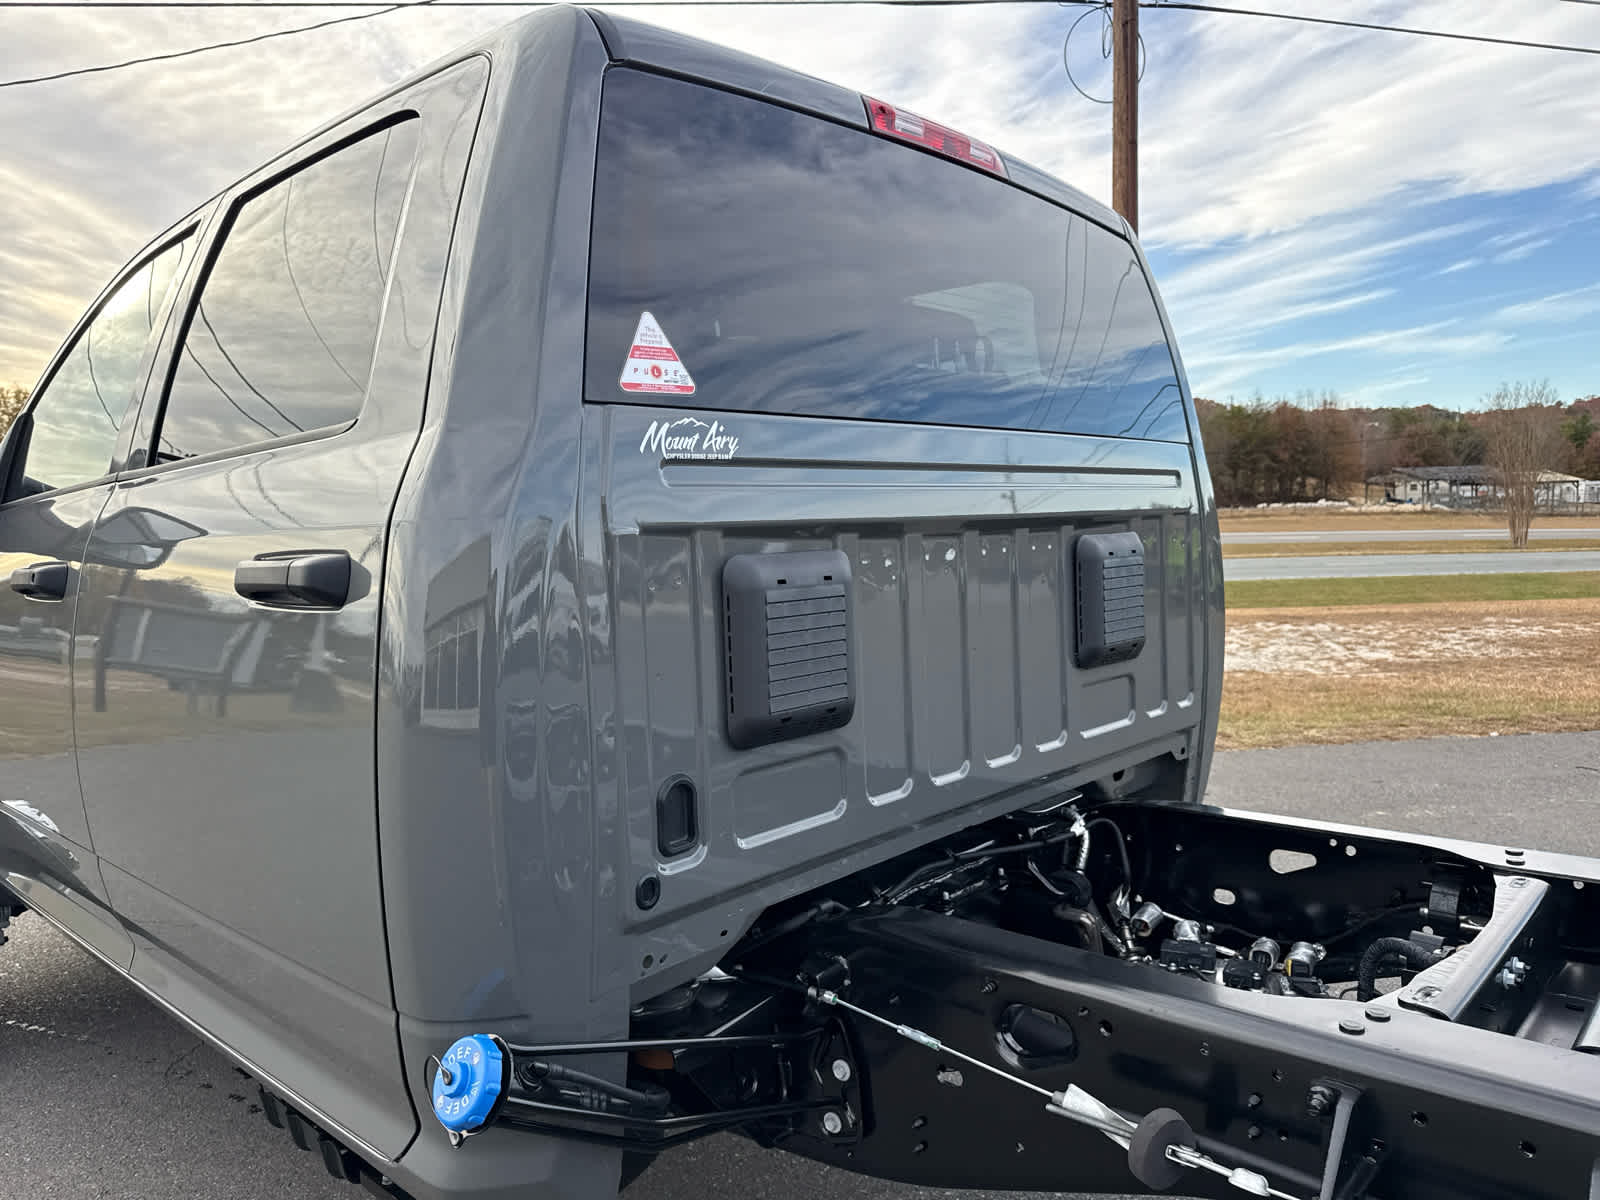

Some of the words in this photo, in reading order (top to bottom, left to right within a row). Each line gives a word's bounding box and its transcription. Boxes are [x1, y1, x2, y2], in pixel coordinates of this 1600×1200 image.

[633, 367, 680, 378] PULSE
[640, 420, 700, 460] Mount
[702, 420, 739, 460] Airy
